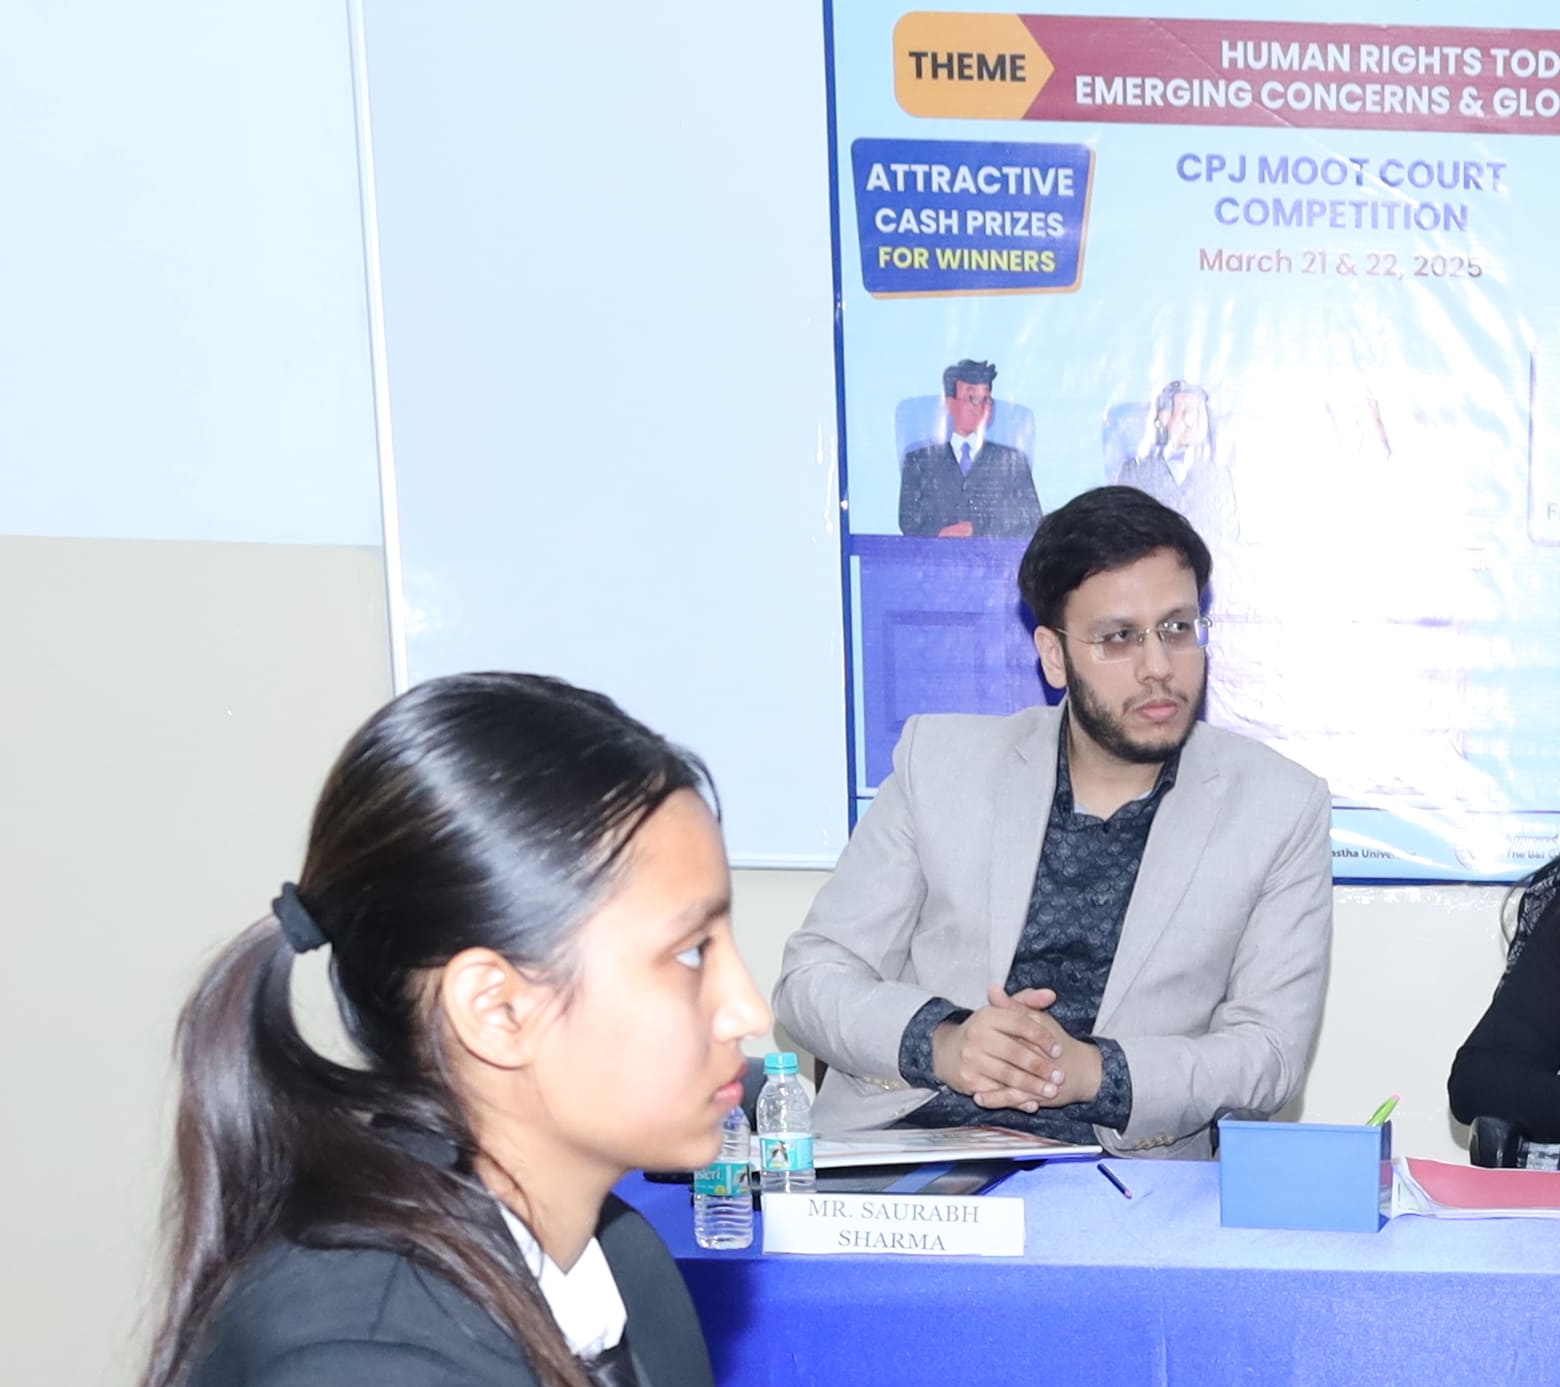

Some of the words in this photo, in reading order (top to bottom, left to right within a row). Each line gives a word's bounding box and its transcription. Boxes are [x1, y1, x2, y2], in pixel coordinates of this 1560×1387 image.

[908, 51, 1027, 83] THEME
[1220, 39, 1351, 73] HUMAN
[1359, 45, 1483, 77] RIGHTS
[1075, 75, 1253, 109] EMERGING
[1260, 81, 1451, 116] CONCERNS
[1458, 87, 1485, 118] &
[866, 162, 1075, 197] ATTRACTIVE
[1176, 153, 1247, 184] CPJ
[1257, 155, 1370, 187] MOOT
[1379, 158, 1508, 192] COURT
[874, 208, 959, 235] CASH
[966, 210, 1065, 238] PRIZES
[1214, 196, 1469, 232] COMPETITION
[878, 246, 930, 270] FOR
[935, 247, 1056, 273] WINNERS
[1199, 248, 1293, 274] March
[1301, 250, 1327, 275] 21
[1336, 251, 1357, 276] &
[1365, 252, 1404, 281] 22,
[1414, 254, 1483, 279] 2025
[808, 1198, 853, 1219] MR.
[860, 1201, 980, 1224] SAURABH
[837, 1230, 946, 1251] SHARMA
